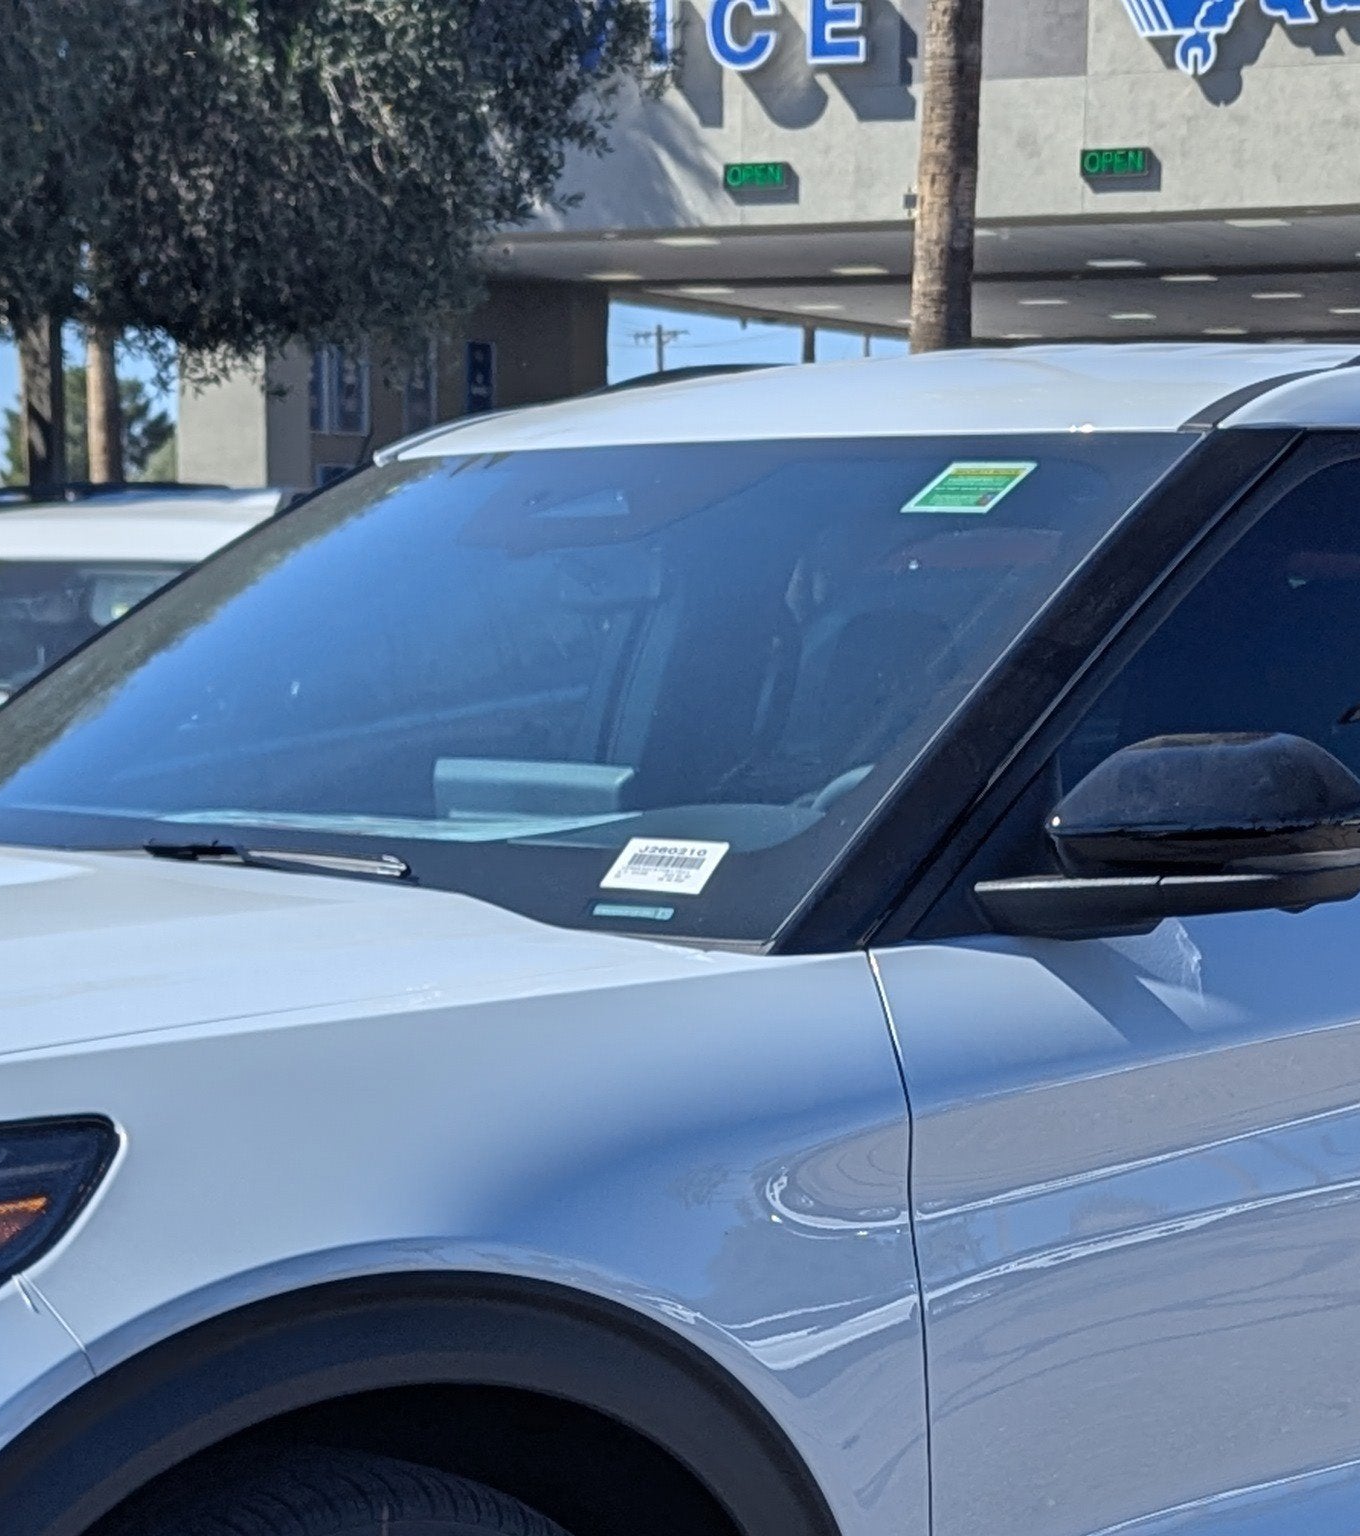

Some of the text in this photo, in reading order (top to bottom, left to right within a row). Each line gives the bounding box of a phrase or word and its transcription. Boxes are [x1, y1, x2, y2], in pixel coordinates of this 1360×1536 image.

[585, 0, 868, 70] ICE
[1084, 150, 1144, 174] OPEN
[726, 163, 784, 187] OPEN
